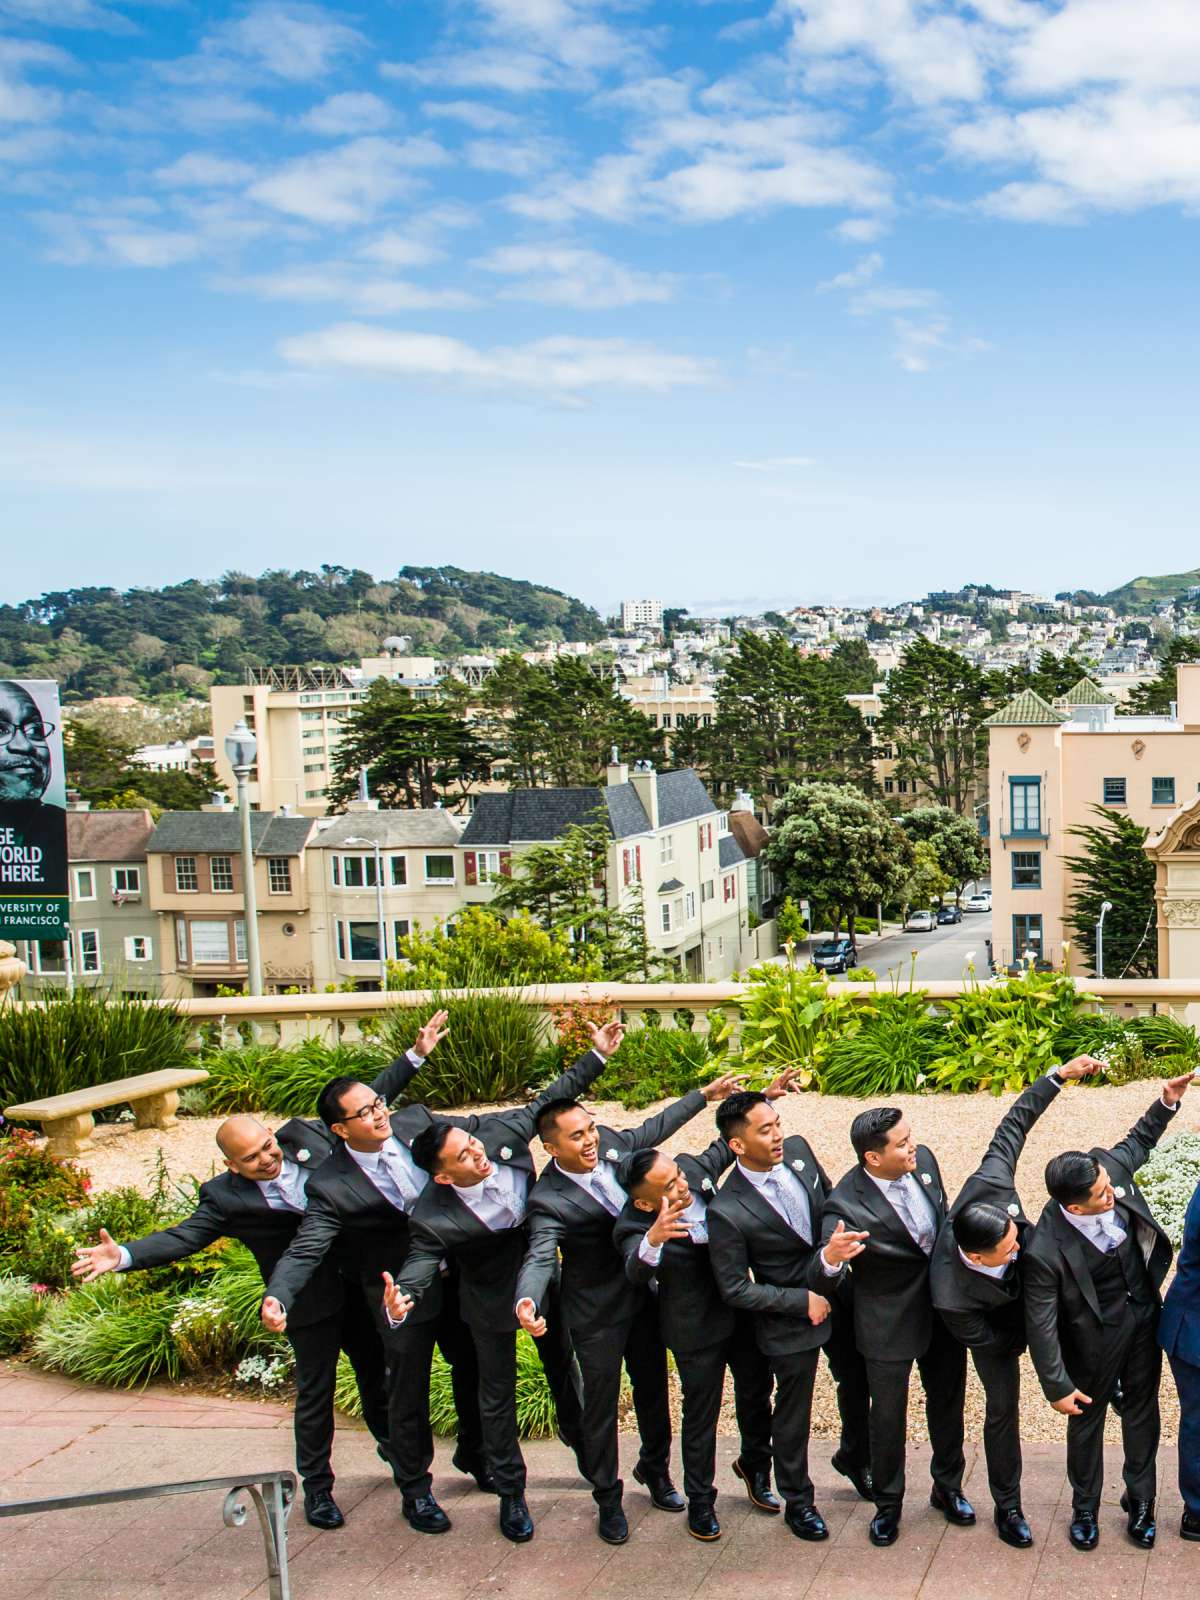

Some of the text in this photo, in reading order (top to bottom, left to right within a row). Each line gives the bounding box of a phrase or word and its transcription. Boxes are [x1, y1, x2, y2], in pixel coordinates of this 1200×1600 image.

[0, 846, 43, 864] ORLD
[1, 865, 45, 882] HERE.
[46, 904, 60, 913] OF
[4, 916, 60, 925] FRANCISCO
